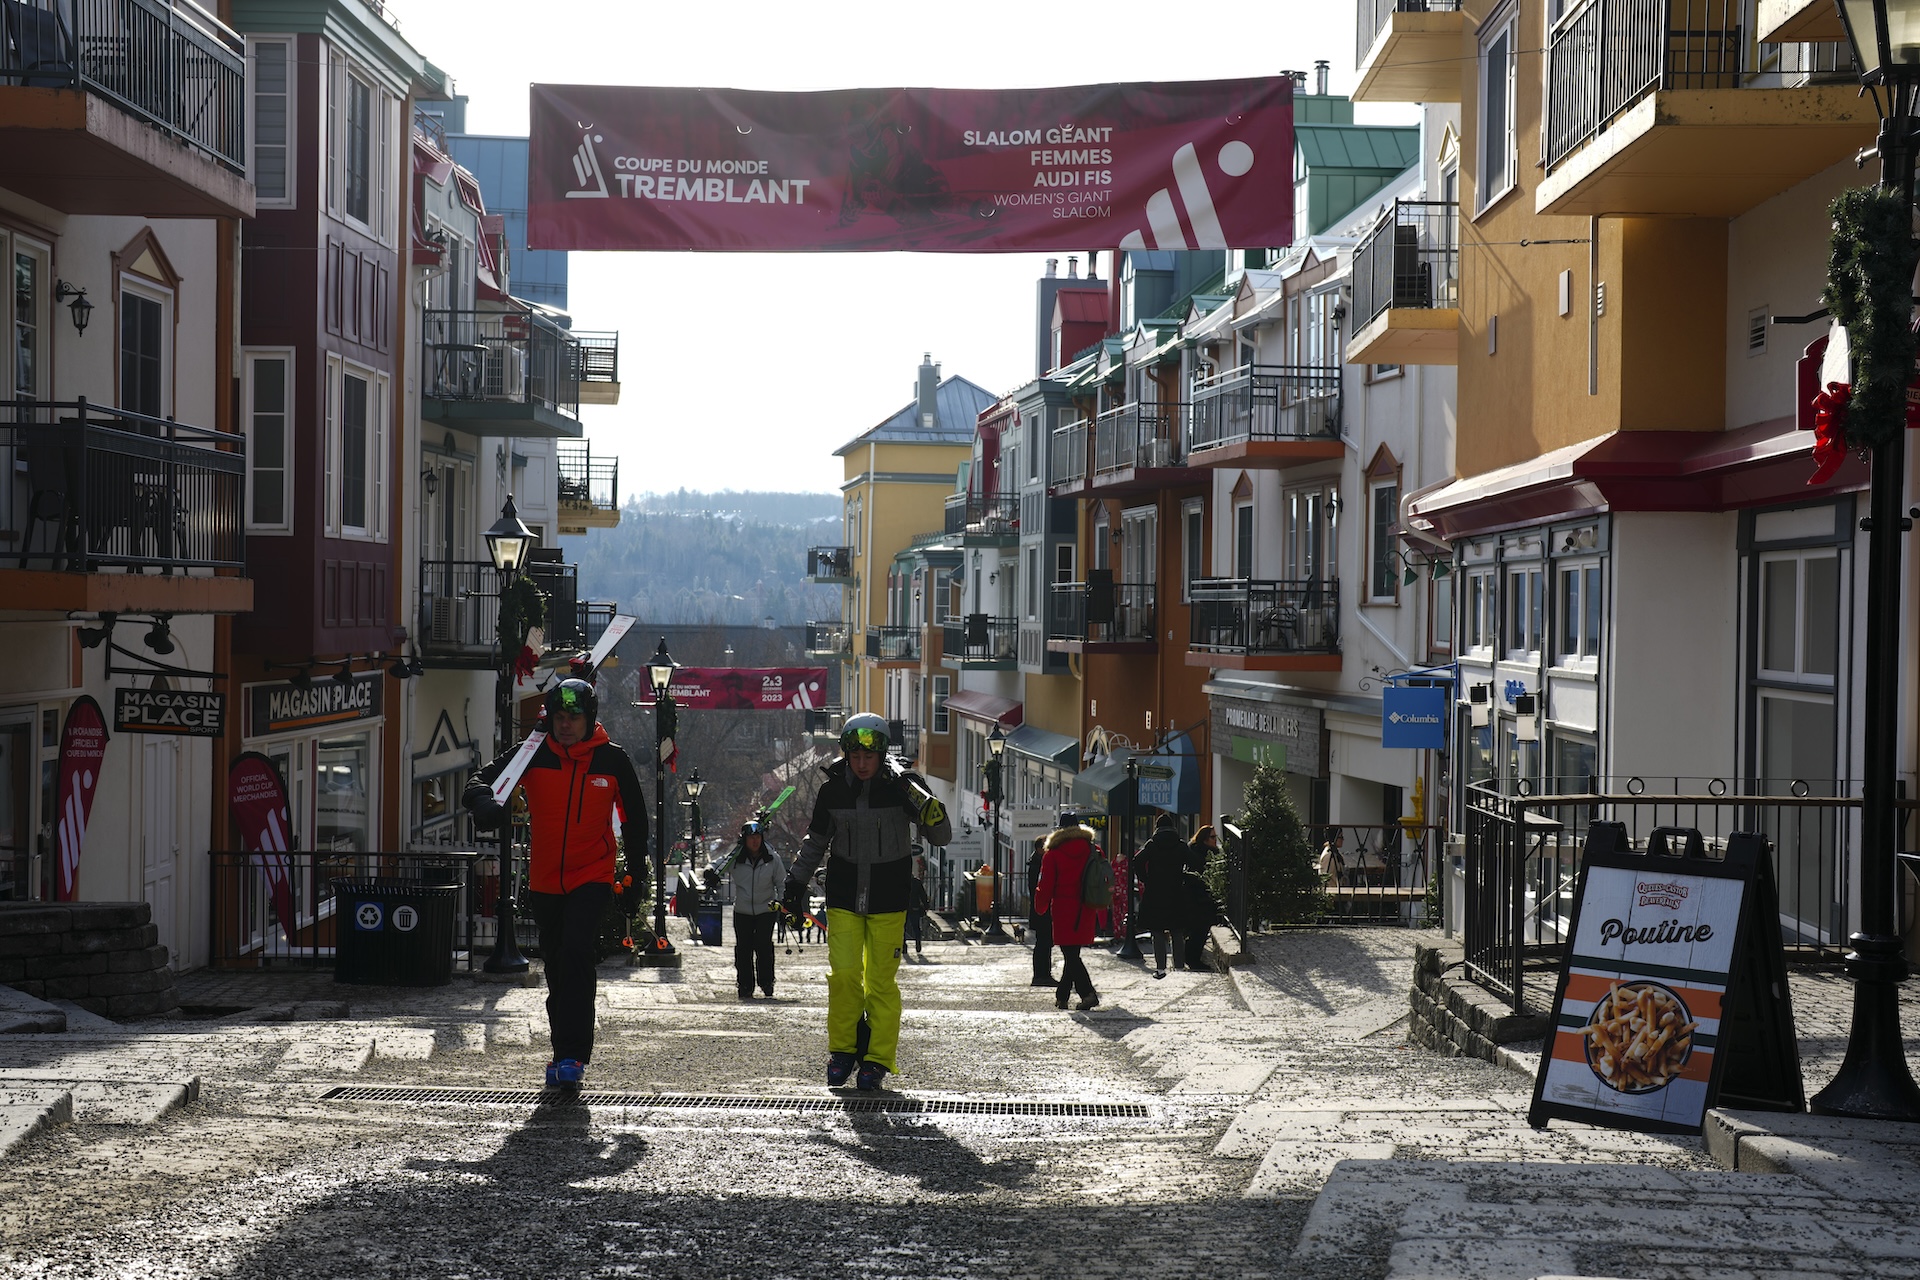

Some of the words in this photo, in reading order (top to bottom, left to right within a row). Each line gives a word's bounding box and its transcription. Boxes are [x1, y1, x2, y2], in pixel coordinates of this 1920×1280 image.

[963, 129, 1041, 146] SLALOM
[1045, 123, 1113, 145] GÉANT
[613, 156, 673, 173] COUPE
[677, 158, 701, 173] DU
[706, 159, 769, 175] MONDE
[1031, 149, 1113, 166] FEMMES
[1033, 171, 1080, 188] AUDI
[1084, 169, 1112, 186] FIS
[614, 173, 811, 205] TREMBLANT
[993, 191, 1065, 206] WOMEN'S
[1067, 189, 1113, 204] GIANT
[1052, 205, 1111, 219] SLALOM
[762, 675, 783, 687] 2&3
[123, 691, 220, 709] MAGASIN
[269, 685, 331, 721] MAGASIN
[333, 681, 372, 711] PLACE
[761, 694, 783, 703] 2023
[123, 705, 220, 728] PLACE
[1225, 707, 1258, 731] PROMENADE
[1400, 713, 1439, 724] Columbia
[189, 726, 219, 734] SPORT
[236, 783, 261, 793] WORLD
[261, 781, 274, 790] CUP
[240, 773, 269, 784] OFFICIAL
[1141, 782, 1171, 792] MAISON
[232, 789, 278, 803] MERCHANDISE
[1141, 792, 1171, 804] BLEUE
[1600, 918, 1714, 946] Poutine
